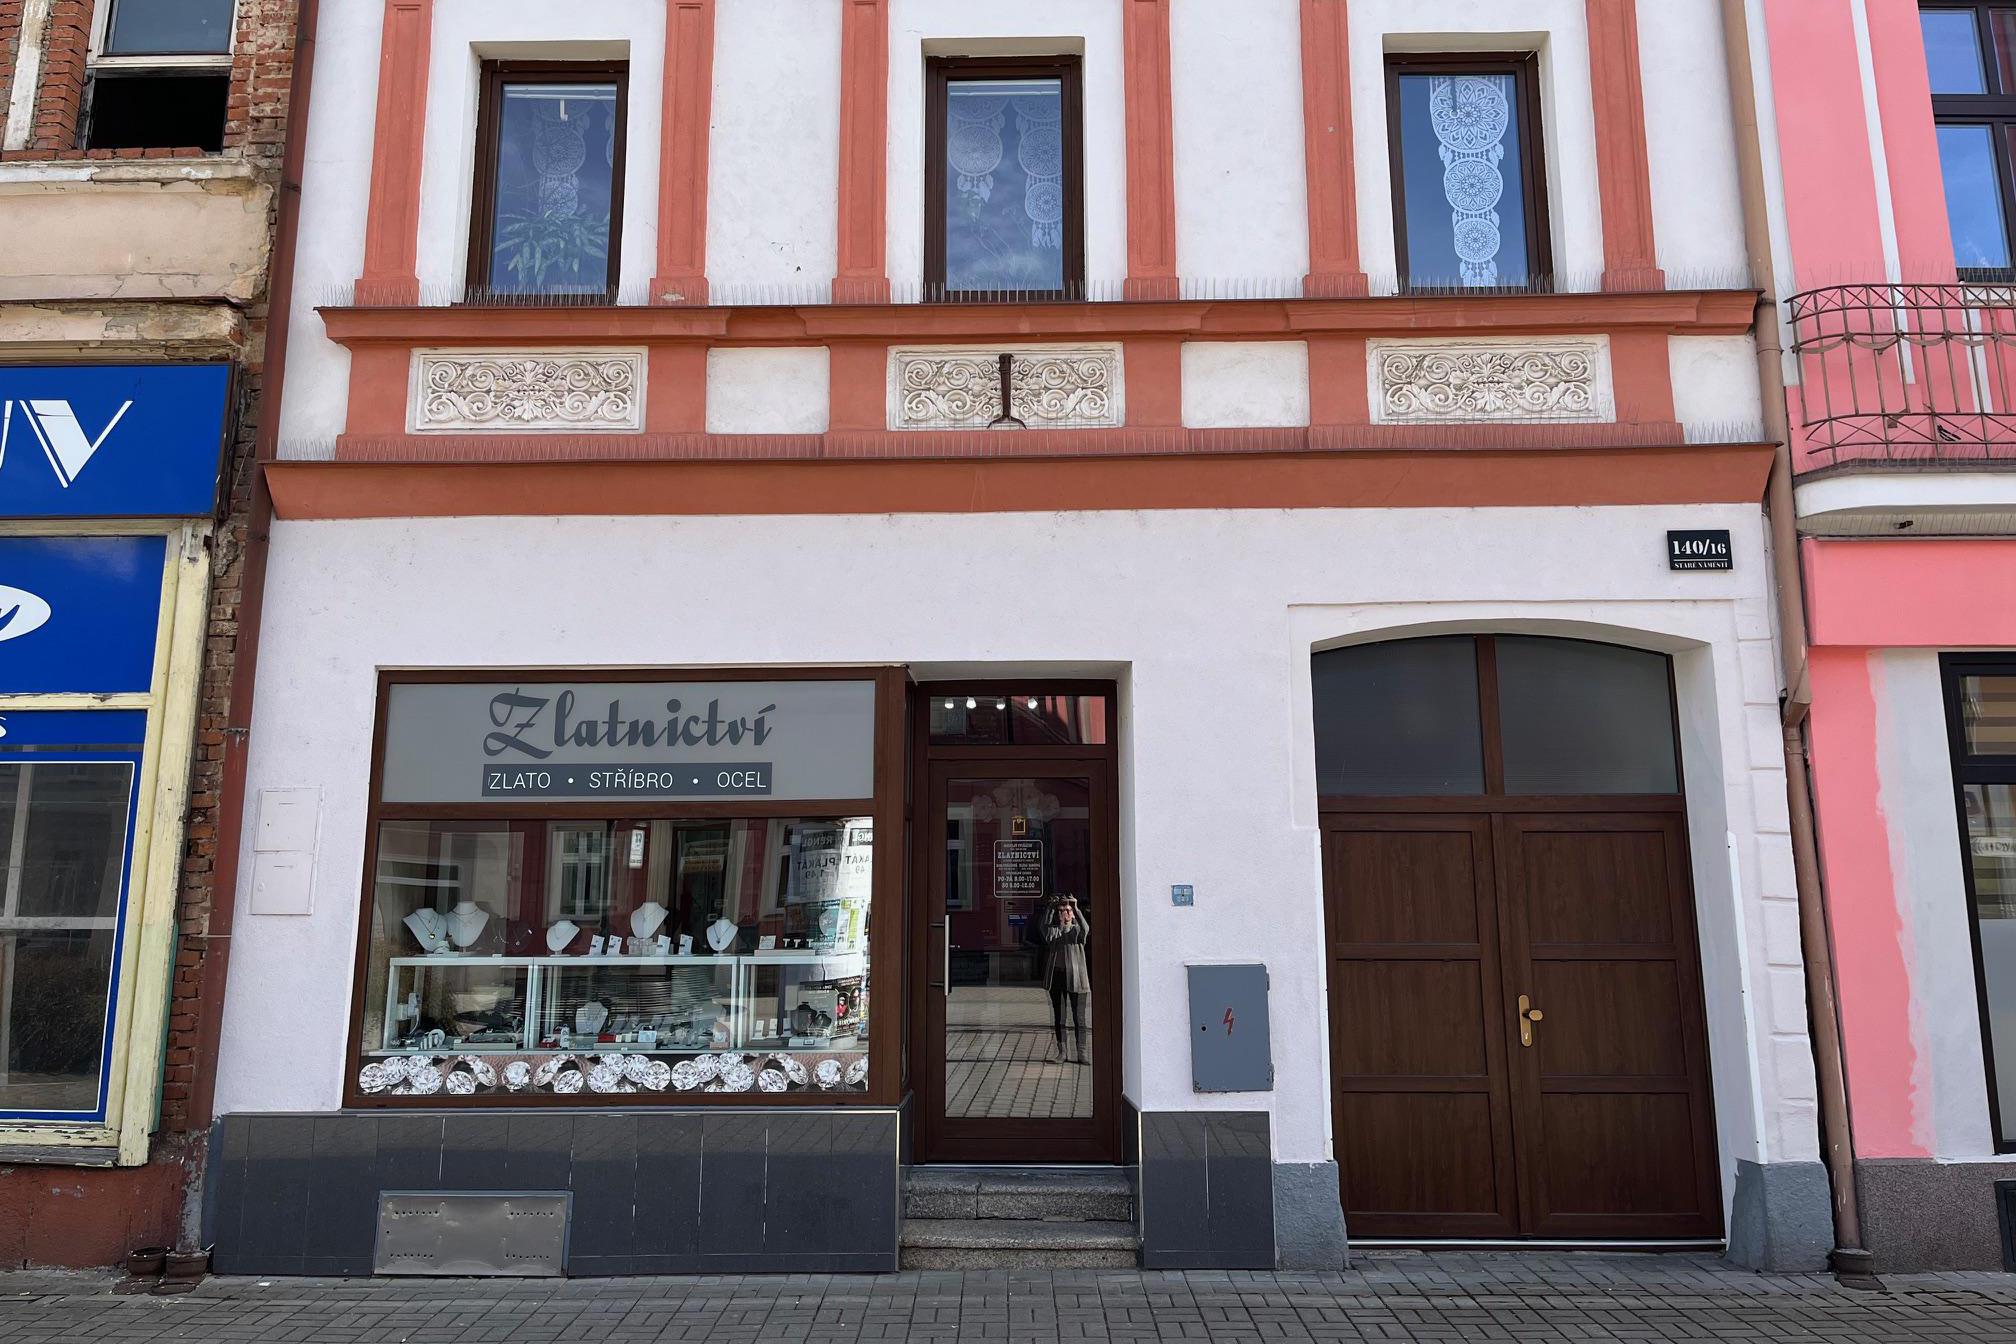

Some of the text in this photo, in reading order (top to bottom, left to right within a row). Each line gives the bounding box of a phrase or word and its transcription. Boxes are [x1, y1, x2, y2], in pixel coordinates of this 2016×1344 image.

[0, 399, 134, 488] V
[1672, 538, 1727, 555] 140/16
[1674, 561, 1697, 569] STARÉ
[482, 687, 777, 760] Zlatnictví
[488, 768, 767, 790] ZLATO STŘÍBRO OCEL
[997, 850, 1040, 859] ZLATNICTVÍ
